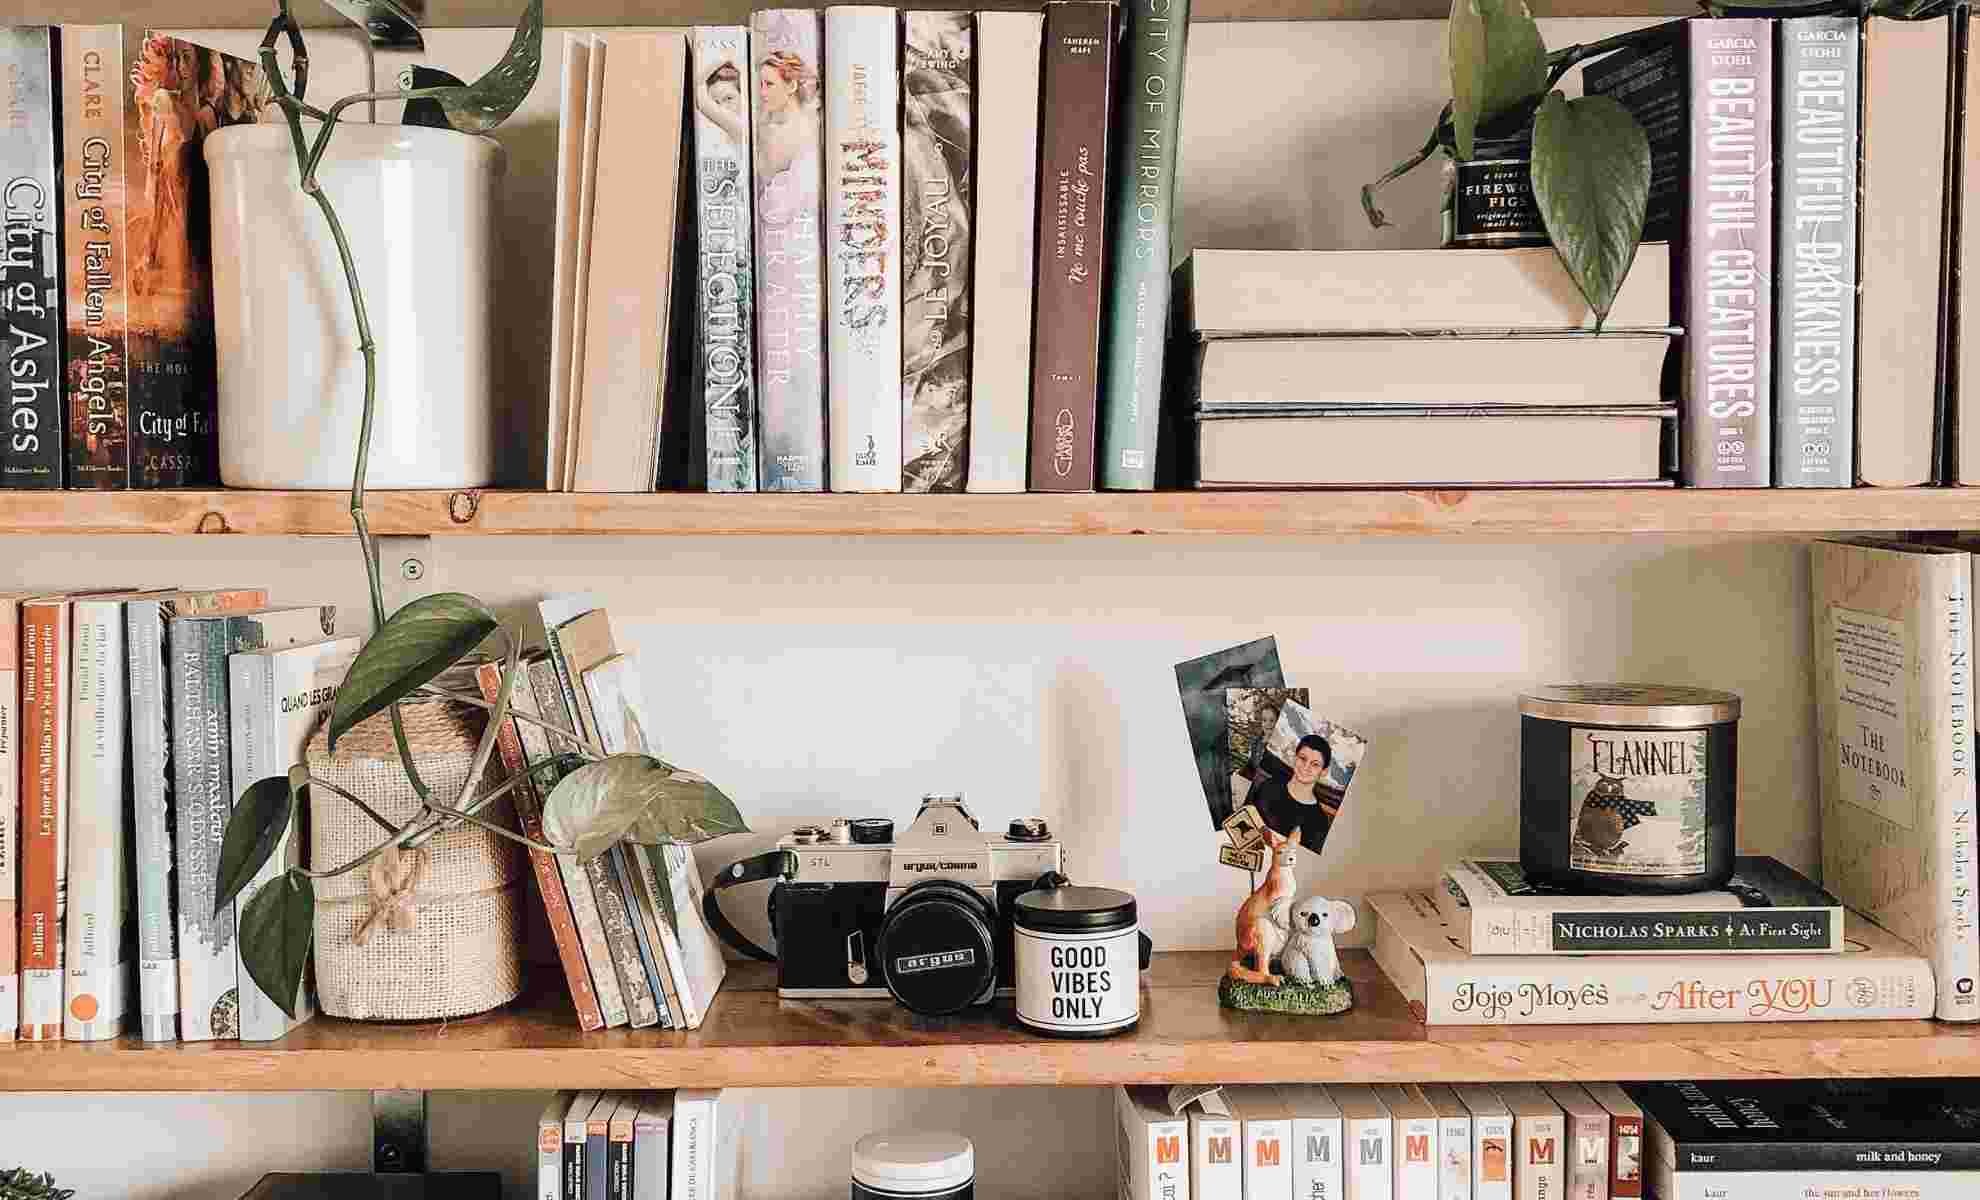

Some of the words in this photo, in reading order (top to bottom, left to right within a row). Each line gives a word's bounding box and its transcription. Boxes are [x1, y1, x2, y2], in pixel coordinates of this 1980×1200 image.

[1148, 0, 1170, 65] CITY
[1708, 38, 1757, 48] GARCIA
[1797, 30, 1846, 41] GARCIA
[84, 50, 102, 120] CLARE
[1143, 73, 1168, 114] OF
[77, 136, 112, 200] City
[1077, 145, 1095, 176] pas
[1707, 78, 1756, 239] BEAUTIFUL
[1796, 70, 1845, 230] BEAUTIFUL
[1056, 168, 1070, 258] INSAISISSABLE
[1134, 128, 1163, 260] MIRRORS
[0, 176, 46, 271] City
[81, 206, 112, 234] of
[923, 177, 951, 278] JOYAU
[6, 281, 46, 319] of
[86, 241, 113, 328] Fallen
[702, 175, 746, 412] SELECTION
[923, 287, 949, 321] LE
[1707, 249, 1756, 418] CREATURES
[1793, 242, 1842, 395] DARKNESS
[8, 325, 49, 454] Ashes
[82, 336, 115, 435] Angels
[140, 411, 172, 441] City
[175, 413, 187, 436] of
[1948, 591, 1965, 632] THE
[205, 709, 223, 759] amin
[1950, 649, 1970, 778] NOTEBOOK
[1586, 732, 1693, 777] FLANNEL
[1860, 725, 1887, 752] THE
[1839, 742, 1907, 789] NOTEBOOK
[1951, 808, 1970, 880] Nicholas
[1558, 922, 1649, 939] NICHOLAS
[1652, 922, 1720, 938] SPARKS
[1739, 922, 1753, 938] At
[1790, 922, 1823, 940] Sight
[1951, 886, 1972, 940] Sparks
[1050, 945, 1107, 968] GOOD
[1051, 970, 1112, 994] VIBES
[1452, 982, 1514, 1020] Jojo
[1650, 979, 1744, 1010] After
[1746, 975, 1835, 1017] YOU
[1051, 997, 1104, 1020] ONLY
[1156, 1135, 1181, 1163] M
[1208, 1136, 1233, 1164] M
[1256, 1139, 1280, 1167] M
[1306, 1135, 1330, 1162] M
[1359, 1138, 1383, 1166] M
[1406, 1135, 1429, 1162] M
[1528, 1137, 1555, 1165] M
[1578, 1136, 1601, 1164] M
[1690, 1152, 1715, 1163] kaur
[1855, 1151, 1882, 1162] milk
[1884, 1151, 1905, 1162] and
[1907, 1151, 1943, 1165] honey
